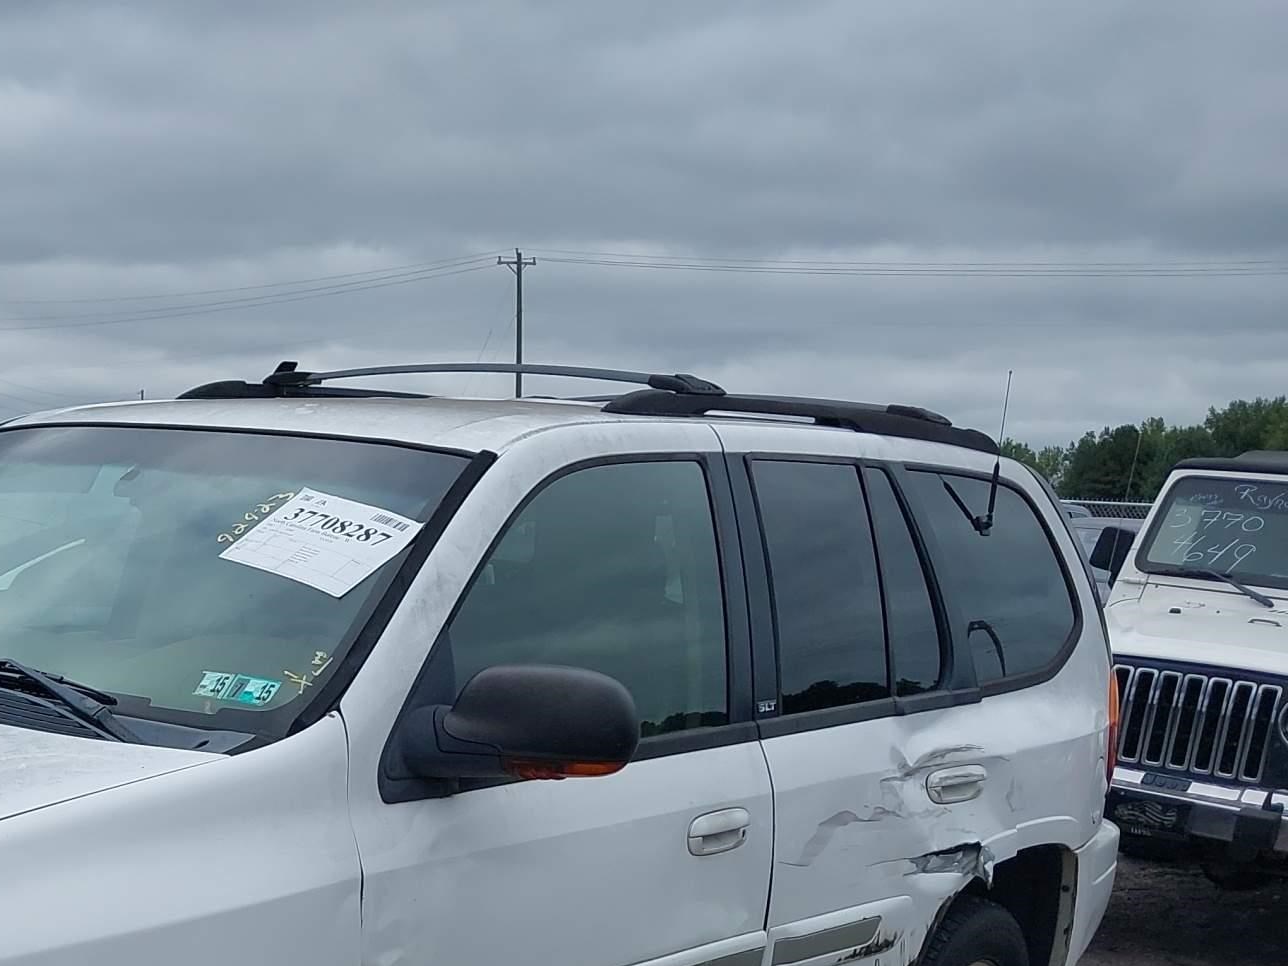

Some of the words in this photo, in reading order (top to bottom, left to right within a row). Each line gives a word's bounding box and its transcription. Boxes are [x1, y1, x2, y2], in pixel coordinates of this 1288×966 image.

[282, 507, 393, 547] 37708287
[1170, 508, 1265, 532] 3770
[210, 676, 230, 693] 15
[255, 683, 276, 701] 15
[758, 702, 776, 713] SLT
